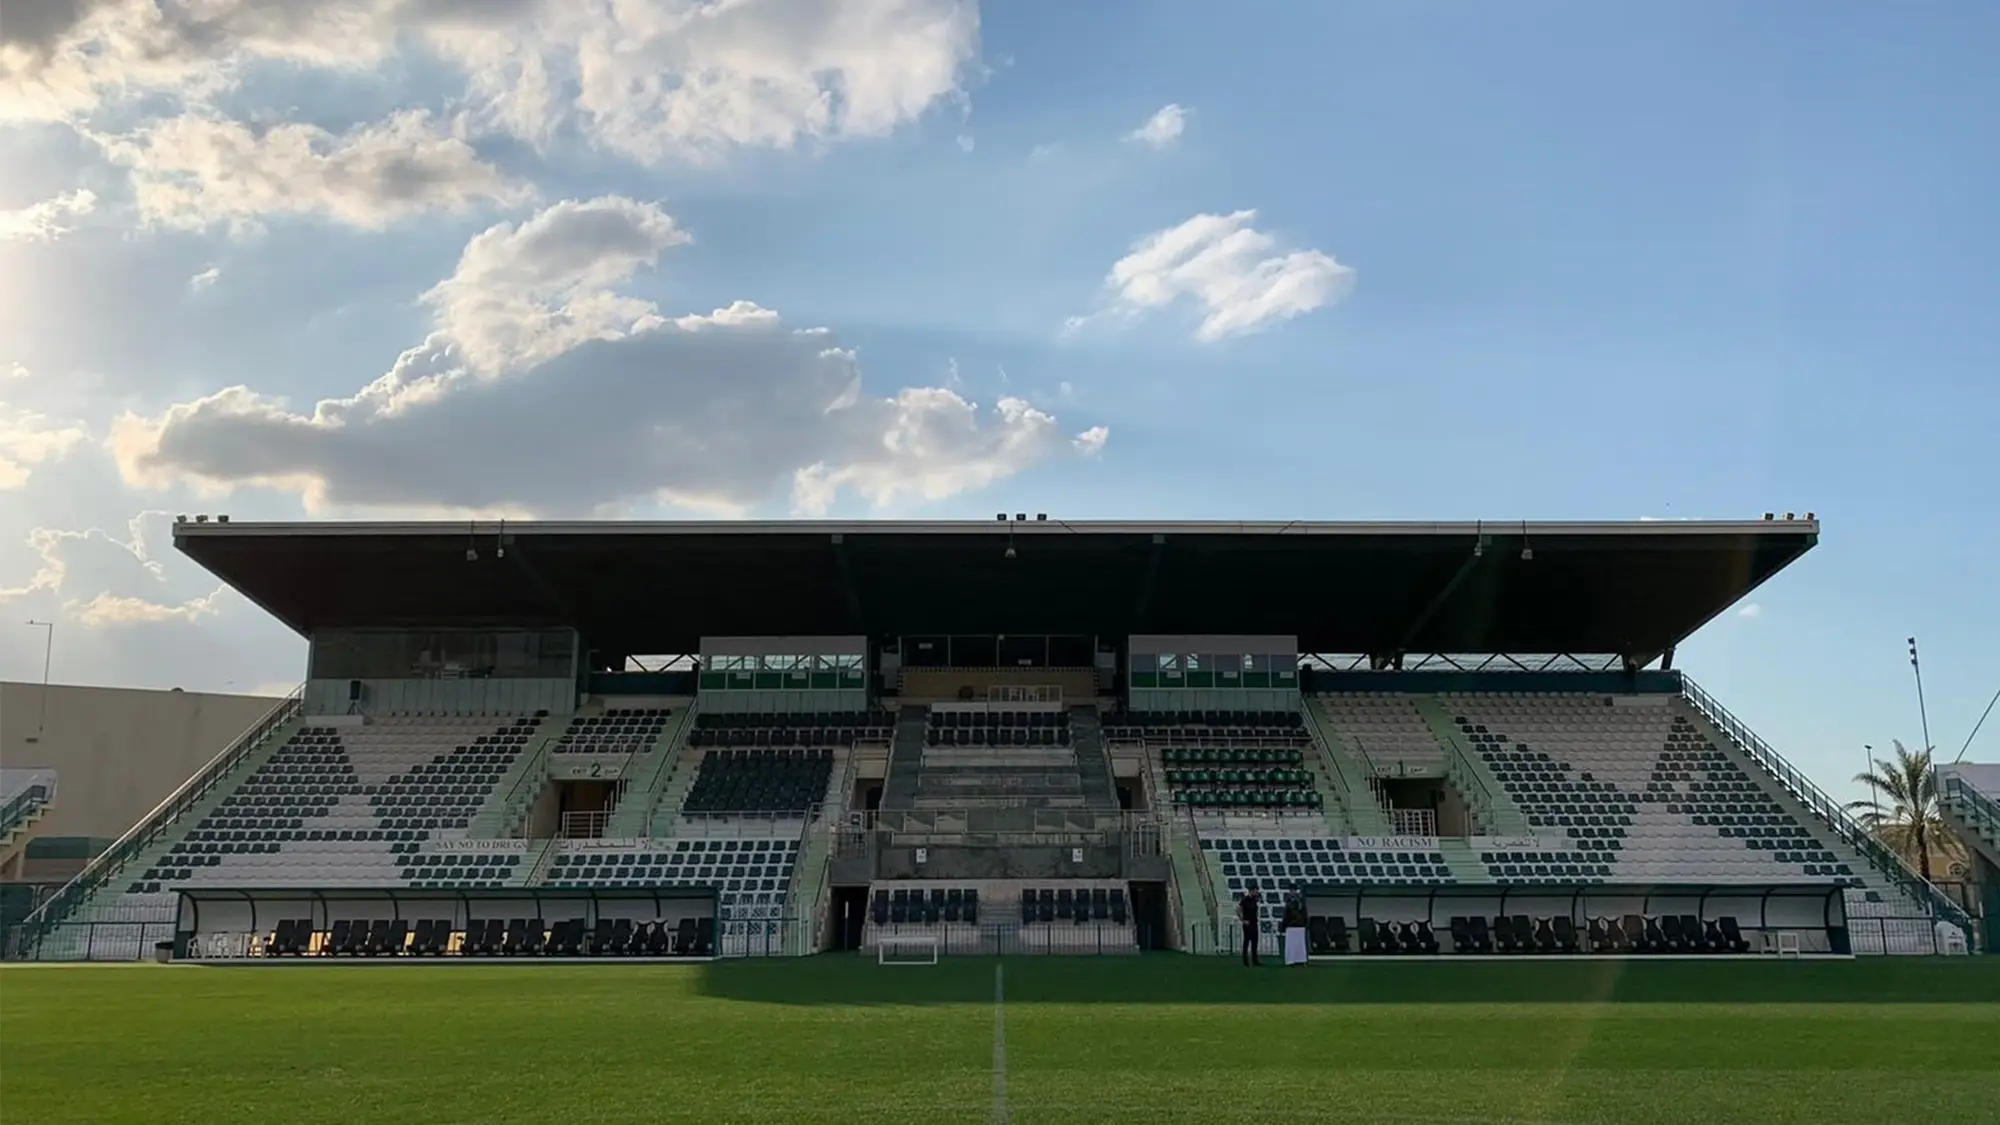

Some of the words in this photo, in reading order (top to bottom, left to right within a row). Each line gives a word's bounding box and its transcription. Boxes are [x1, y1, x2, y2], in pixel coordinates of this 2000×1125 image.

[591, 762, 601, 777] 2
[1397, 760, 1407, 777] 1
[435, 840, 453, 849] SAY
[458, 840, 473, 849] NO
[477, 840, 490, 849] TO
[492, 840, 527, 849] DRUGS
[1357, 837, 1376, 848] NO
[1382, 837, 1432, 848] RACISM
